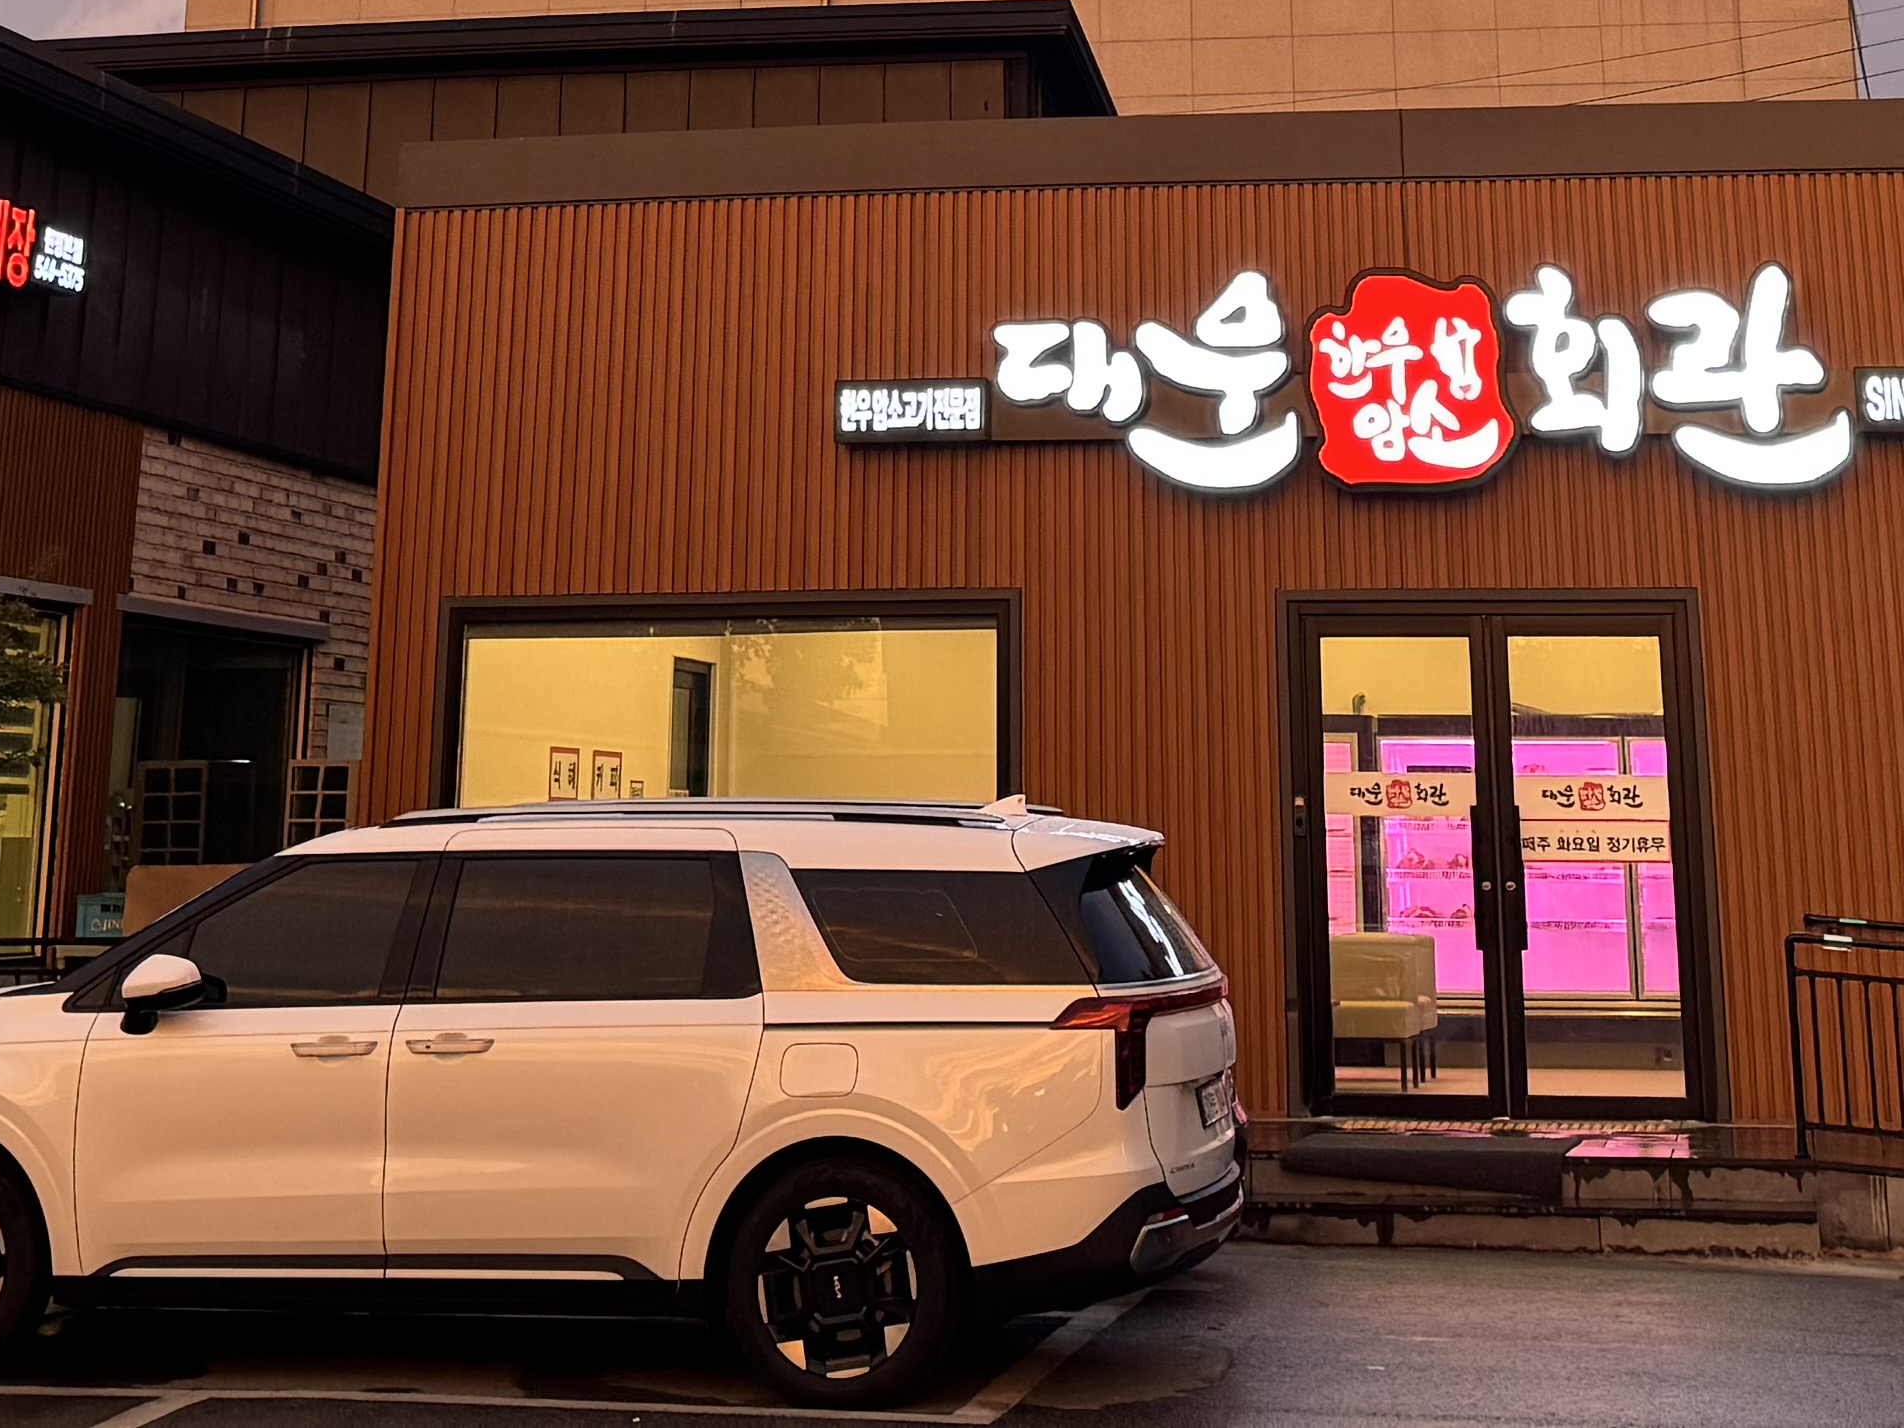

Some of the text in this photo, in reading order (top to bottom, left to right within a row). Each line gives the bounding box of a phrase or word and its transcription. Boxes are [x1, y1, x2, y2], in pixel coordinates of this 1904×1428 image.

[1318, 316, 1425, 406] 한우
[1506, 265, 1851, 484] 회관
[1352, 379, 1499, 469] 암소
[1556, 836, 1600, 852] 화요일
[1607, 836, 1666, 852] 정기휴무
